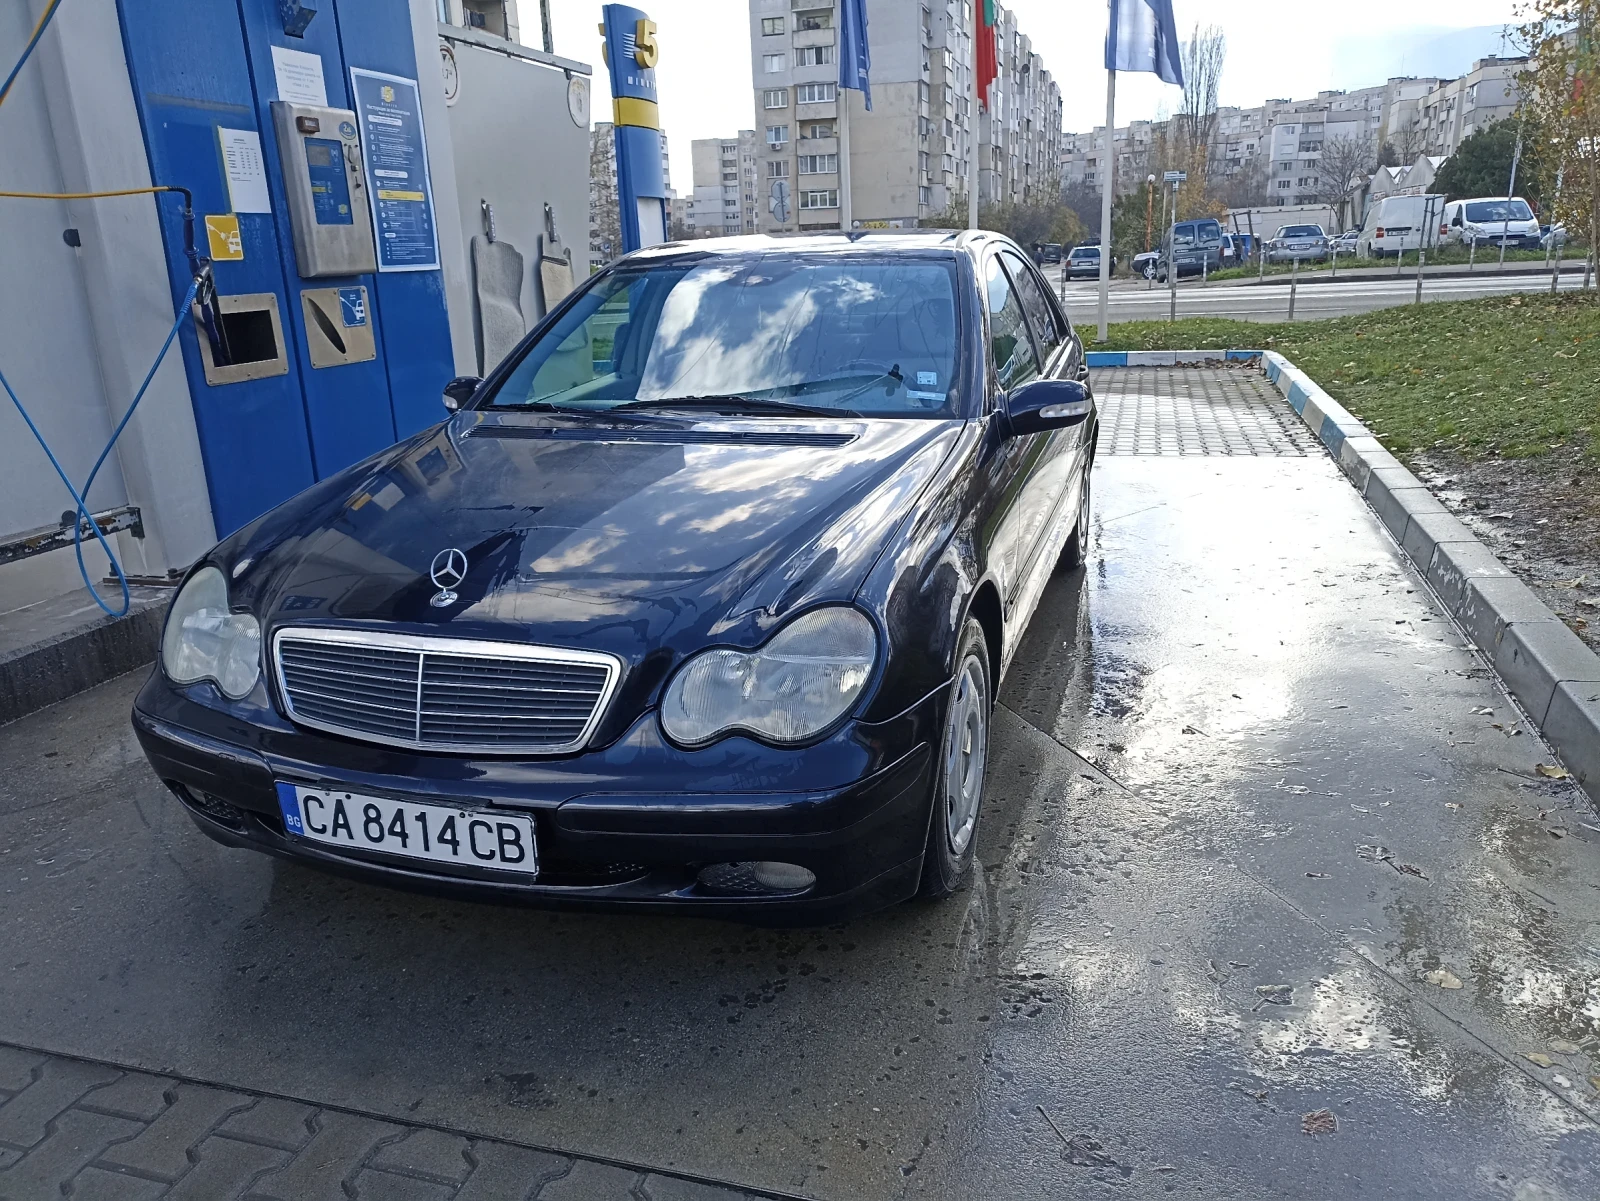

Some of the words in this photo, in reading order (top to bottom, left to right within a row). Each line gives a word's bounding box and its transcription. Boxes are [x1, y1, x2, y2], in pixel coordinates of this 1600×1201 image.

[636, 19, 658, 70] 5
[287, 814, 301, 828] BG
[362, 803, 461, 857] 8414
